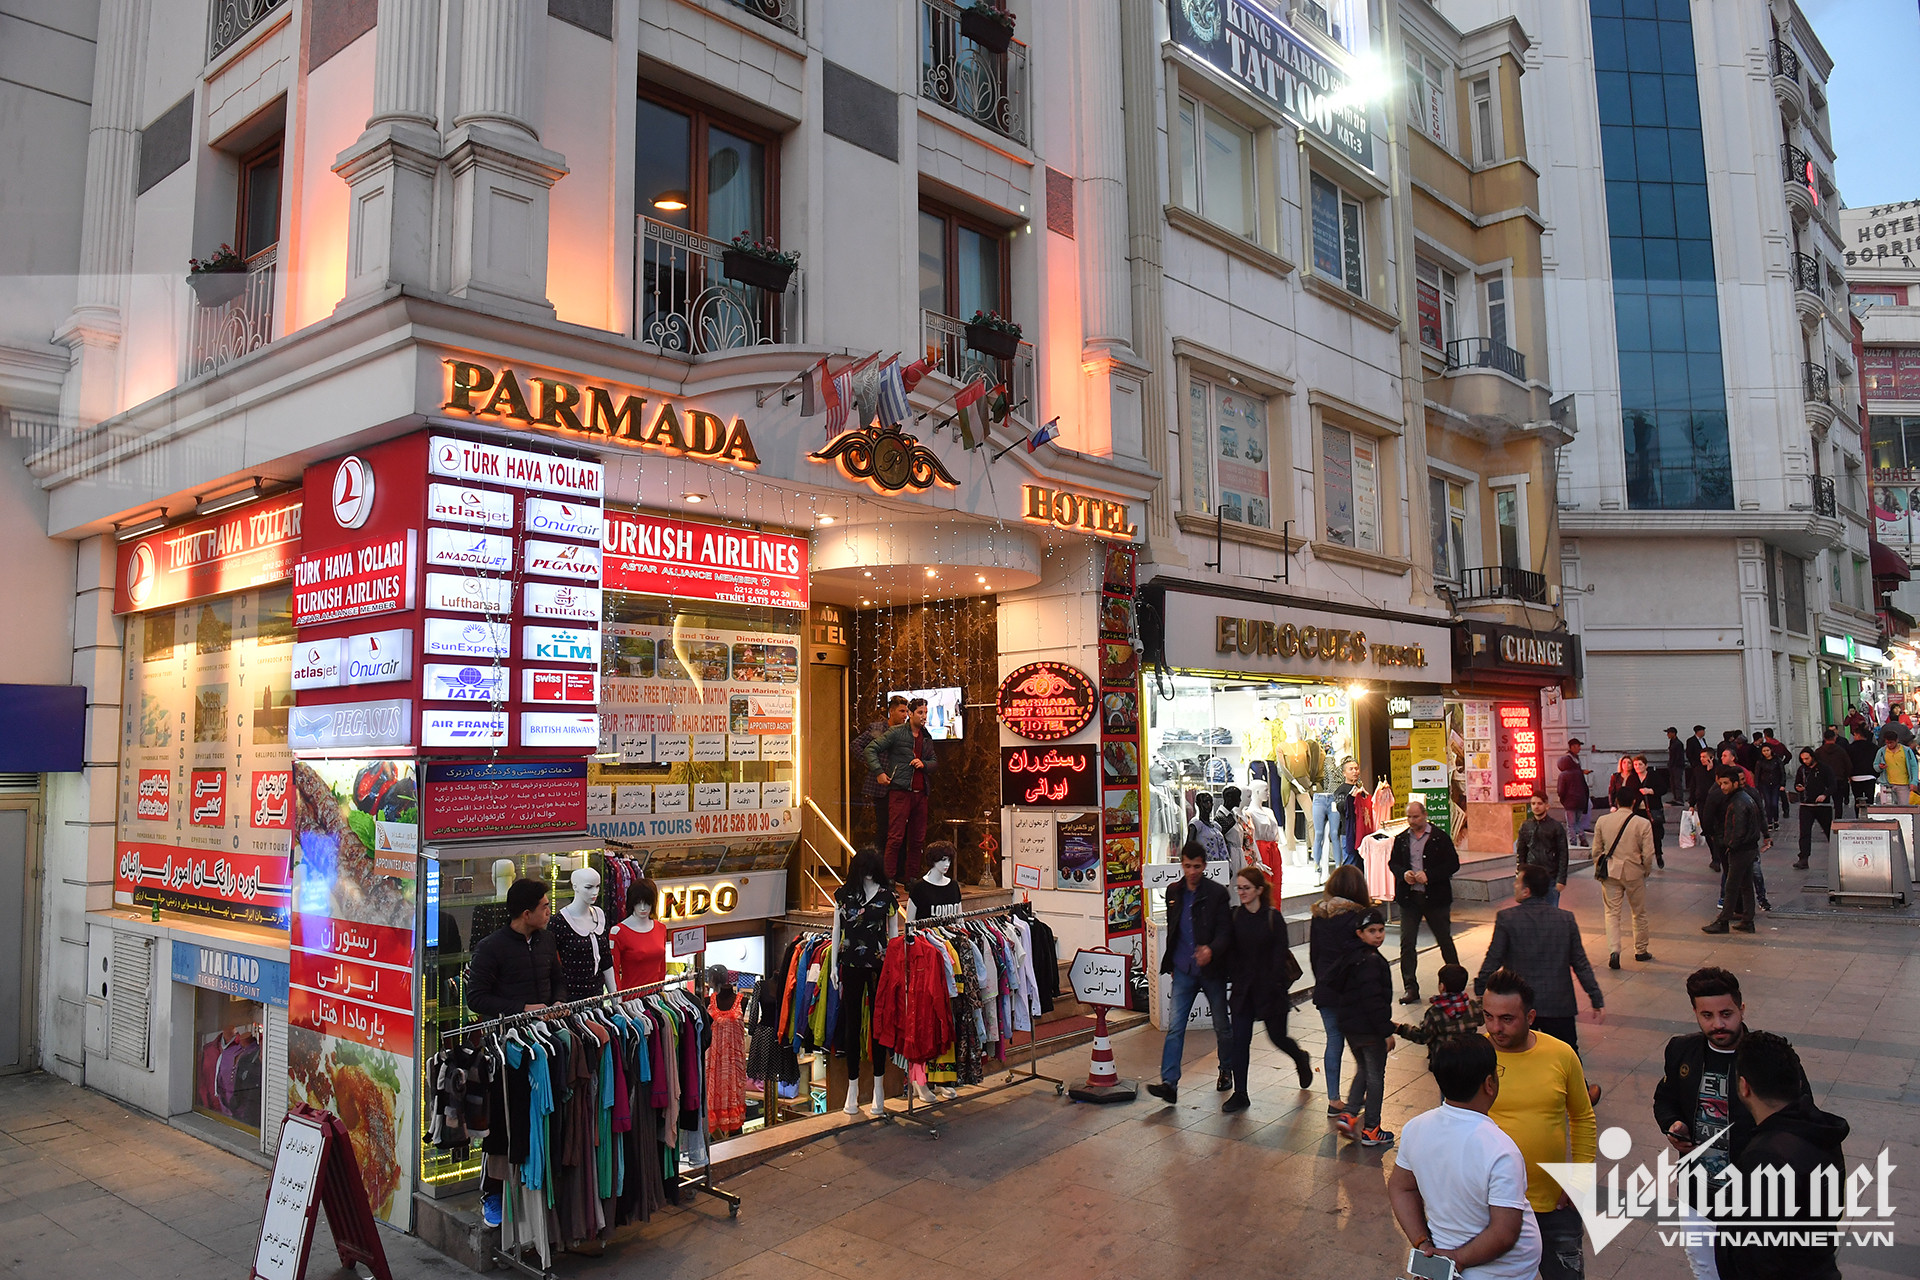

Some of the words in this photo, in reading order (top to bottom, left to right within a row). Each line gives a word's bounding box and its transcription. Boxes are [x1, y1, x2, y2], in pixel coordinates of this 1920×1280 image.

[1226, 0, 1272, 50] KING
[1277, 30, 1329, 91] MARIO
[1225, 27, 1333, 135] TATTOO
[1336, 123, 1363, 154] KAT:3
[1858, 214, 1920, 243] HOTE
[446, 358, 762, 465] PARMADA
[464, 444, 501, 477] TÜRK
[506, 456, 543, 484] HAVA
[548, 462, 600, 492] YOLLARI
[435, 503, 510, 523] atlasjet
[1022, 484, 1138, 538] HOTEL
[533, 514, 599, 536] Onurair
[170, 527, 202, 568] TÜRK
[207, 520, 243, 558] HAVA
[603, 518, 693, 561] URKISH
[700, 533, 799, 575] AIRLINES
[294, 555, 321, 587] TÜRK
[323, 550, 354, 580] HAVA
[356, 540, 404, 574] YOLLARI
[435, 551, 507, 567] ANADOLUJET
[531, 558, 599, 576] PEGASUS
[661, 566, 713, 581] ALLIANCE
[714, 573, 759, 586] MEMBER
[296, 585, 343, 614] TURKISH
[345, 575, 400, 604] AIRLINES
[733, 585, 754, 595] 0212
[754, 587, 769, 596] 526
[769, 589, 781, 597] 80
[781, 590, 790, 598] 30
[321, 606, 358, 621] ALLIANCE
[360, 600, 396, 614] MEMBER
[441, 595, 501, 611] Lufthansa
[535, 604, 597, 618] Emirates
[771, 597, 809, 609] ACENTASI
[699, 633, 721, 641] Tour
[736, 635, 765, 644] Dinner
[766, 637, 795, 645] Cruise
[431, 642, 509, 655] SunExpress
[536, 643, 592, 659] KLM
[1499, 634, 1563, 666] CHANGE
[294, 663, 338, 680] atlasjet
[349, 657, 400, 679] Onurair
[535, 673, 562, 683] swiss
[448, 688, 492, 700] IATA
[617, 685, 639, 704] HOUSE
[643, 686, 660, 704] FREE
[729, 686, 750, 696] Aqua
[751, 686, 779, 695] Marine
[1011, 697, 1077, 707] PARMADA
[1305, 695, 1347, 708] KIDS
[1004, 707, 1033, 717] BEST
[1035, 706, 1085, 717] QUALITY
[332, 704, 401, 738] PEGASUS
[431, 719, 454, 729] AIR
[457, 719, 505, 729] FRANCE
[530, 725, 562, 733] BRITISH
[563, 726, 595, 734] AIRWAYS
[656, 713, 676, 733] TOUR
[681, 714, 700, 733] HAIR
[700, 714, 728, 733] CENTER
[749, 721, 776, 730] APPOINTED
[776, 722, 792, 730] AGENT
[1020, 720, 1068, 732] HOTEL
[1307, 716, 1346, 727] WEAR
[1008, 749, 1086, 773] رستوران
[1025, 777, 1069, 803] ایرانی
[1504, 782, 1533, 798] DÖVİZ
[586, 819, 646, 839] PARMADA
[649, 817, 692, 836] TOURS
[694, 815, 711, 834] +90
[712, 813, 729, 833] 212
[730, 813, 746, 833] 526
[746, 812, 759, 832] 80
[759, 811, 770, 831] 30
[252, 841, 267, 850] TROY
[269, 842, 289, 853] TOURS
[766, 834, 786, 842] Tour
[376, 859, 402, 871] APPOINTED
[402, 861, 416, 872] AGENT
[1151, 868, 1182, 883] ایرانی
[321, 922, 377, 959] رستوران
[677, 932, 684, 946] 5
[685, 931, 699, 941] TL
[200, 947, 260, 985] VIALAND
[1083, 961, 1122, 978] رستوران
[198, 973, 219, 989] TICKET
[219, 979, 239, 994] SALES
[239, 983, 261, 999] POINT
[317, 963, 379, 1000] ایرانی
[1083, 981, 1122, 996] ایرانی
[311, 998, 338, 1027] هتل
[342, 1004, 385, 1048] پارمادا
